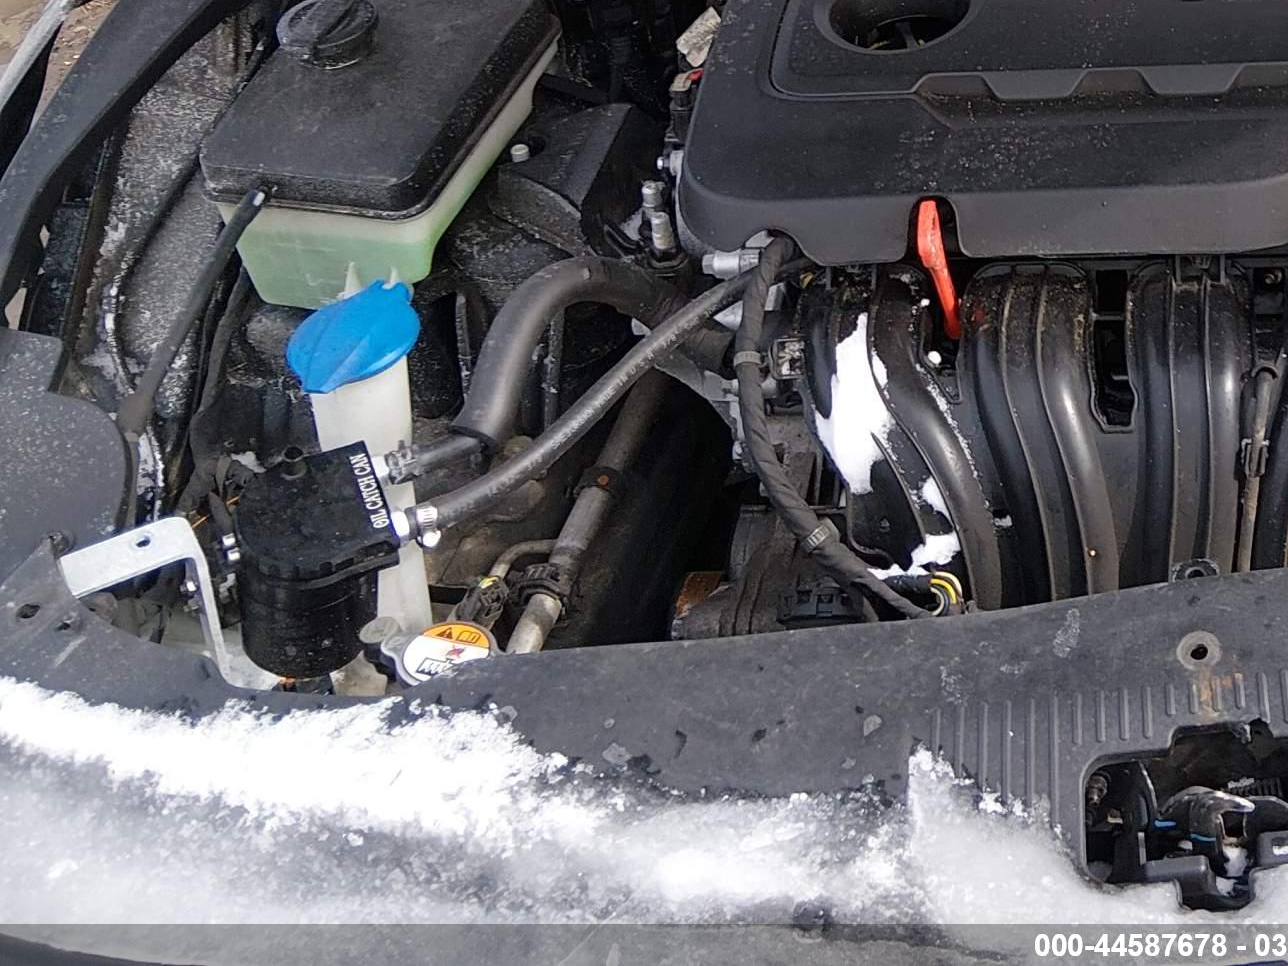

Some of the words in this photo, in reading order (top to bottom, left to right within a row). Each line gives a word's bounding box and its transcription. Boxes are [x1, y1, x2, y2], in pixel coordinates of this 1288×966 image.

[349, 453, 371, 475] CAN
[357, 475, 383, 510] CATCH
[370, 509, 390, 528] OIL
